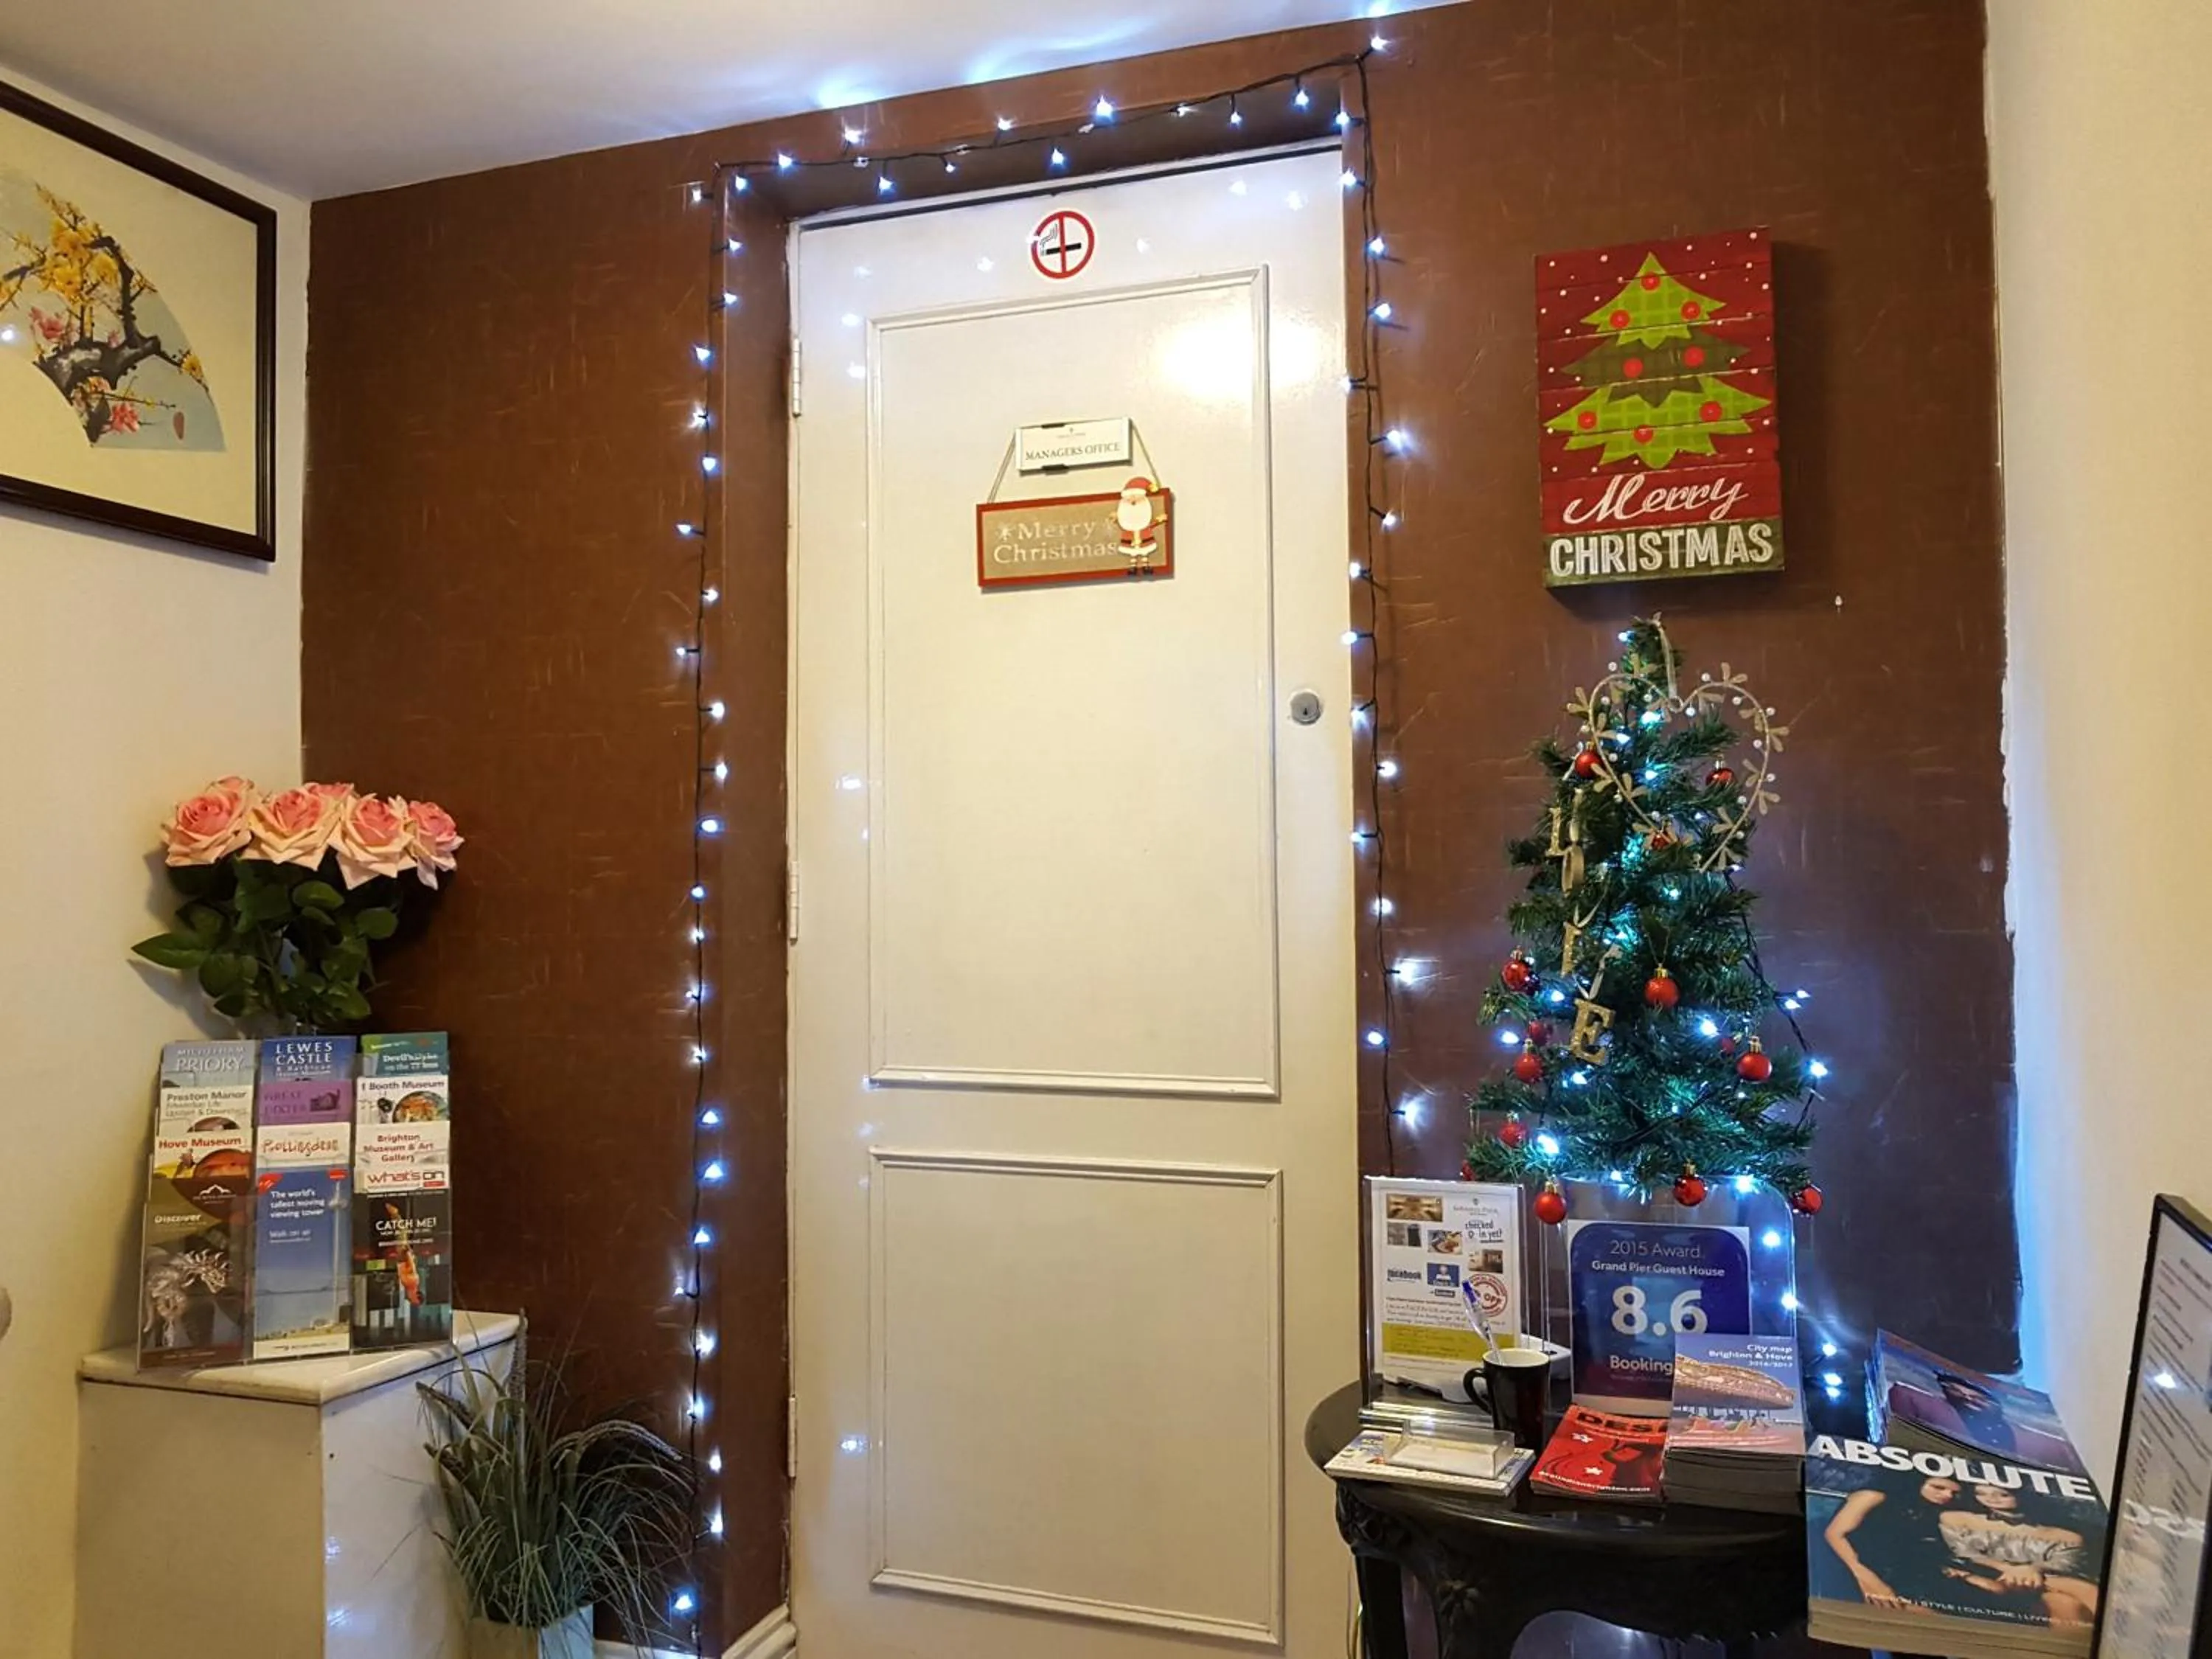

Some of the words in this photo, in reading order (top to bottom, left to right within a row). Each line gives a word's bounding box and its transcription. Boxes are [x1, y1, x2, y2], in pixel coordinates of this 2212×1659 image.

[1026, 446, 1083, 460] MANAGERS
[1085, 442, 1120, 454] OFFICE
[1562, 474, 1749, 524] Merry
[1018, 520, 1096, 541] Merry
[994, 542, 1117, 565] Christmas
[1550, 523, 1774, 577] CHRISTMAS
[275, 1042, 333, 1054] LEWES
[176, 1055, 245, 1072] PRIORY
[276, 1053, 331, 1065] CASTLE
[369, 1082, 398, 1090] Booth
[402, 1081, 445, 1089] Museum
[167, 1093, 208, 1101] Preston
[159, 1140, 188, 1149] Hove
[192, 1137, 242, 1147] Museum
[377, 1134, 420, 1144] Brighton
[364, 1144, 405, 1152] Museum
[381, 1154, 414, 1163] Gallery
[366, 1169, 421, 1183] what's
[423, 1171, 445, 1180] on
[375, 1217, 413, 1231] CATCH
[417, 1217, 437, 1228] ME!
[1610, 1239, 1648, 1255] 2015
[1651, 1243, 1700, 1259] Award
[1592, 1260, 1627, 1272] Grand
[1630, 1262, 1650, 1273] Pier
[1652, 1263, 1686, 1275] Guest
[1688, 1266, 1725, 1276] House
[1611, 1285, 1708, 1336] 8.6
[1708, 1350, 1752, 1359] Brighton
[1746, 1344, 1768, 1353] City
[1807, 1435, 2097, 1501] ABSOLUTE
[1920, 1600, 1954, 1610] STYLE
[1963, 1606, 2017, 1618] CULTURE
